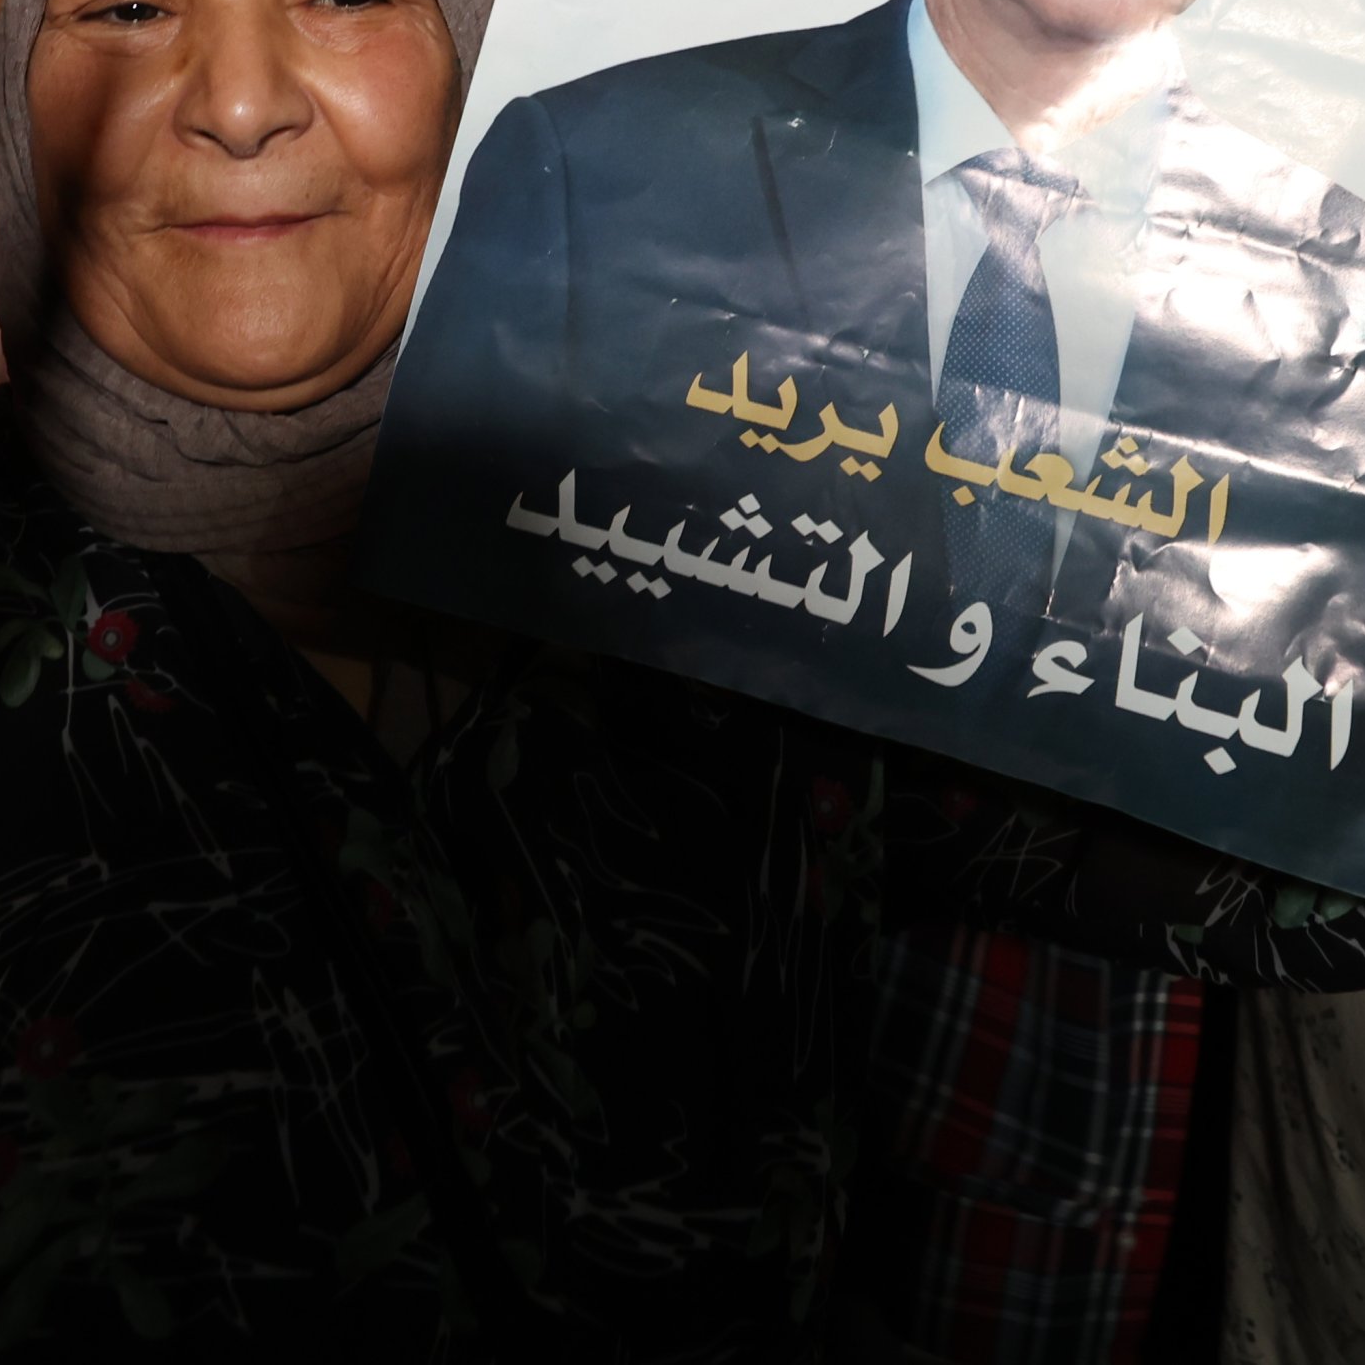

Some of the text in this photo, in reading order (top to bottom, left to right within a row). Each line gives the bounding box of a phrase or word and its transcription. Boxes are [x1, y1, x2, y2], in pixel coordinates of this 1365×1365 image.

[685, 349, 1230, 547] الشعب يريد
[505, 467, 1356, 777] البناء و التشييد
